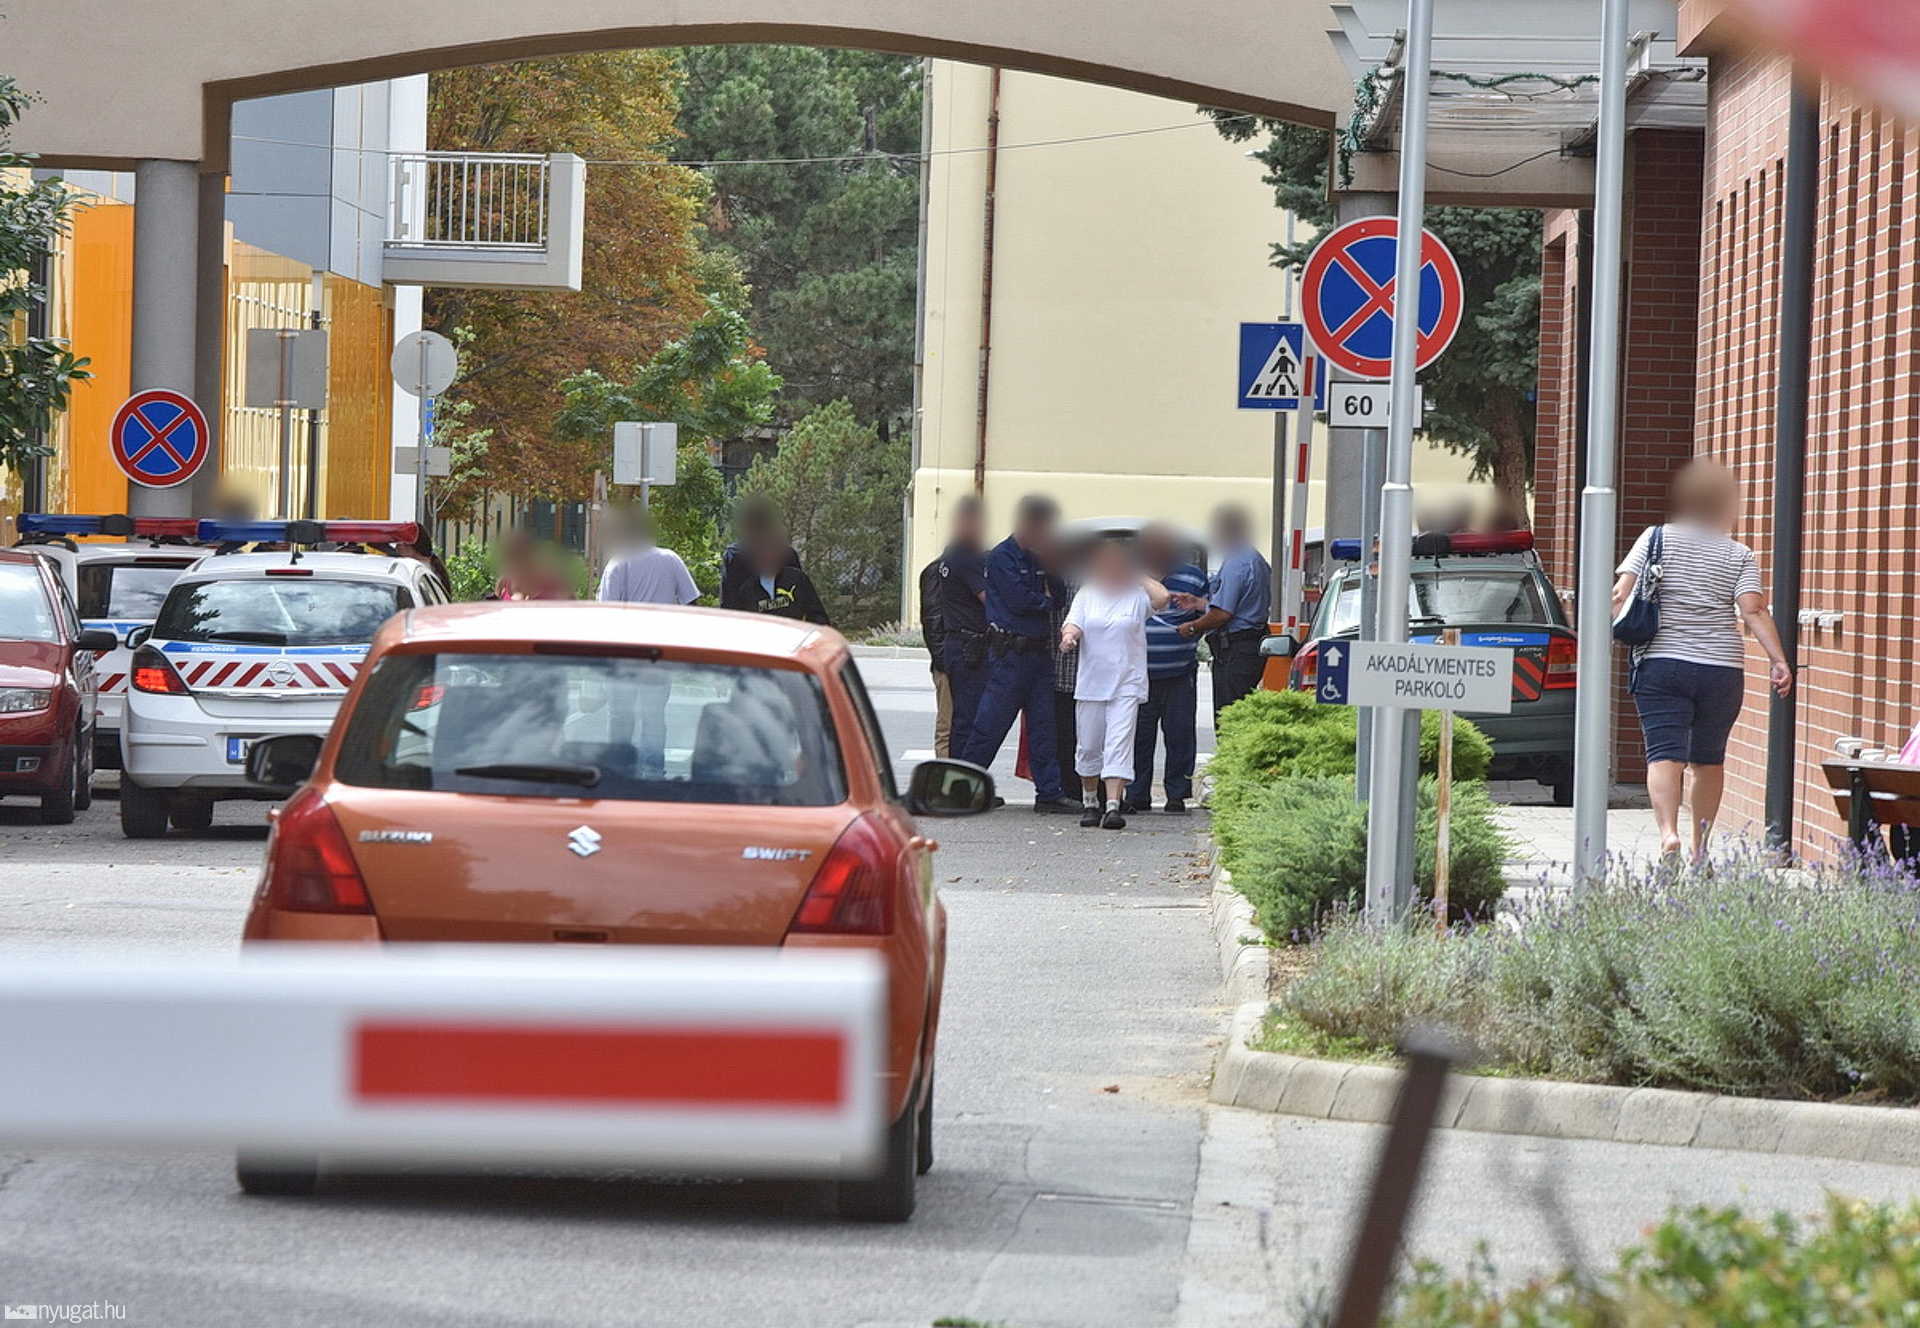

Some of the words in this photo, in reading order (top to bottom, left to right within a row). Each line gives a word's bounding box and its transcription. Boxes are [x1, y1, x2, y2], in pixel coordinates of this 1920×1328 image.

[1344, 395, 1372, 416] 60
[1366, 653, 1496, 677] AKADÁLYMENTES
[1395, 679, 1466, 700] PARKOLÓ
[358, 830, 433, 843] SUZUKI
[742, 846, 815, 862] SWIFT
